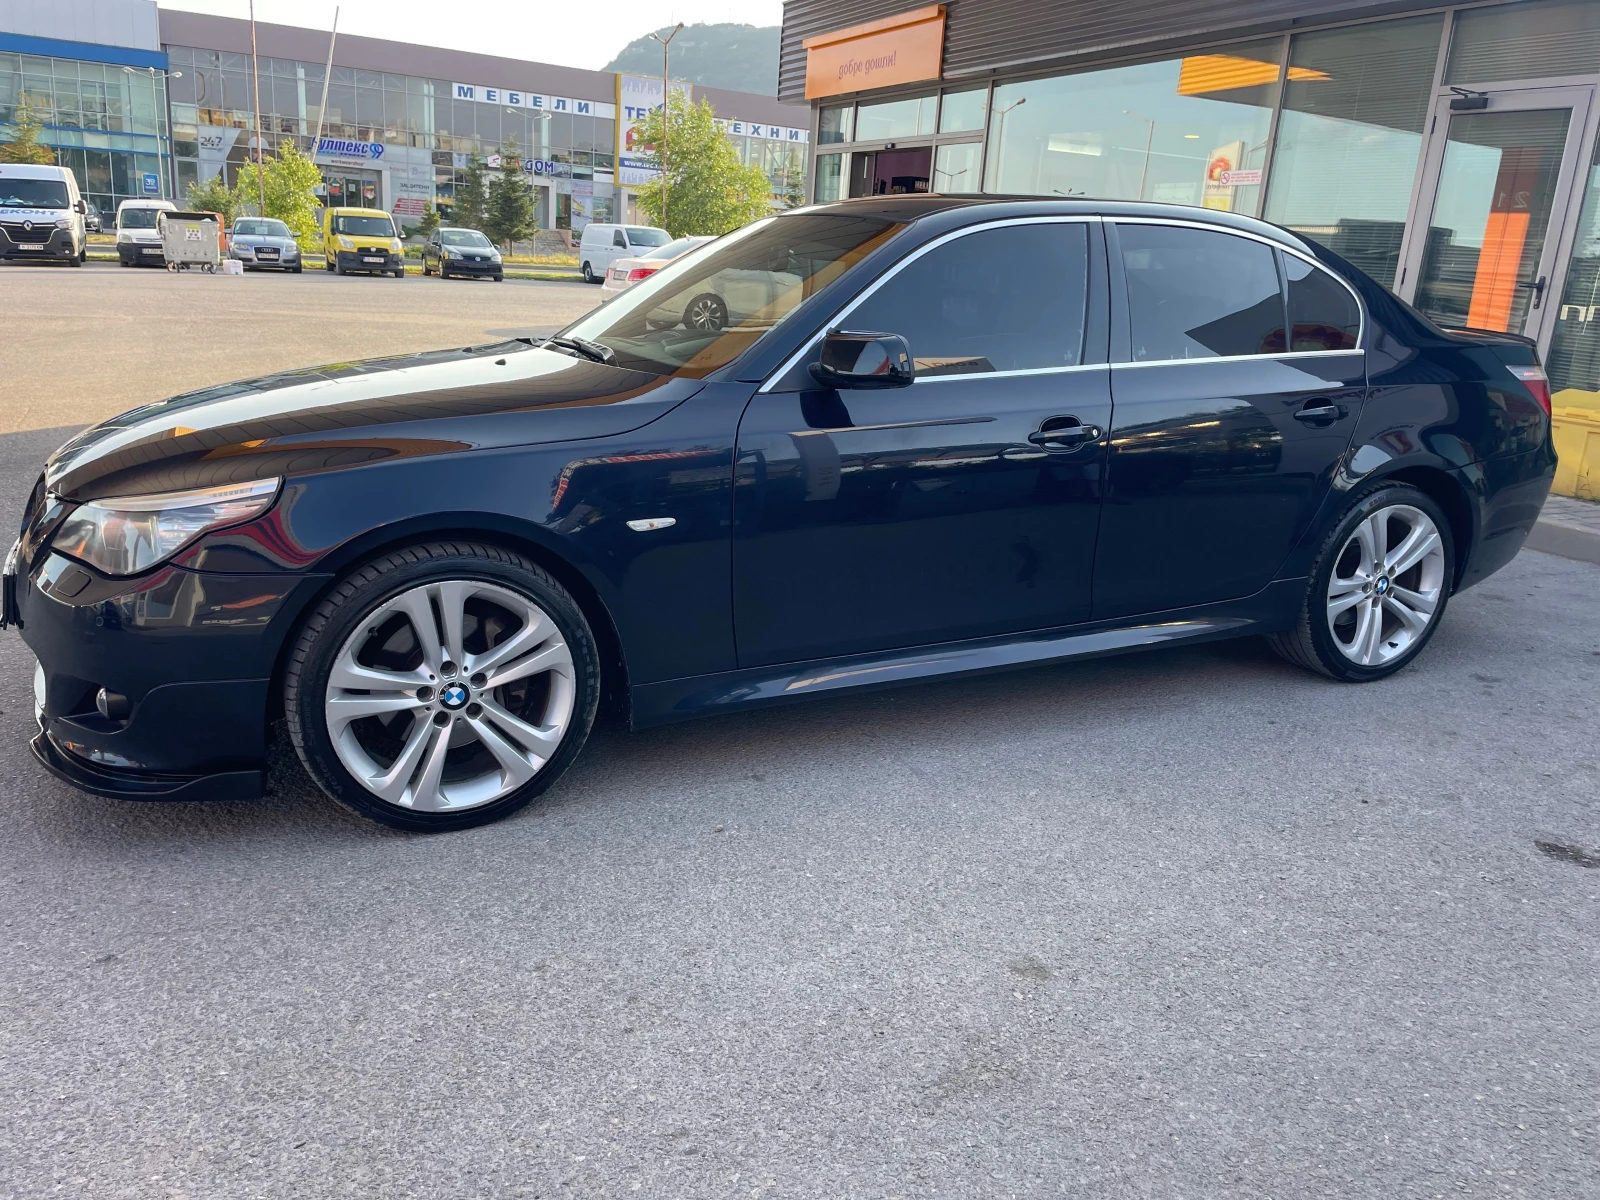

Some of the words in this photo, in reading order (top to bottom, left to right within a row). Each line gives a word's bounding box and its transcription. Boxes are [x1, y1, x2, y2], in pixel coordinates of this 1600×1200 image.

[838, 59, 863, 80] добре
[865, 50, 897, 75] дошли!
[457, 85, 590, 114] МЕБЕЛИ
